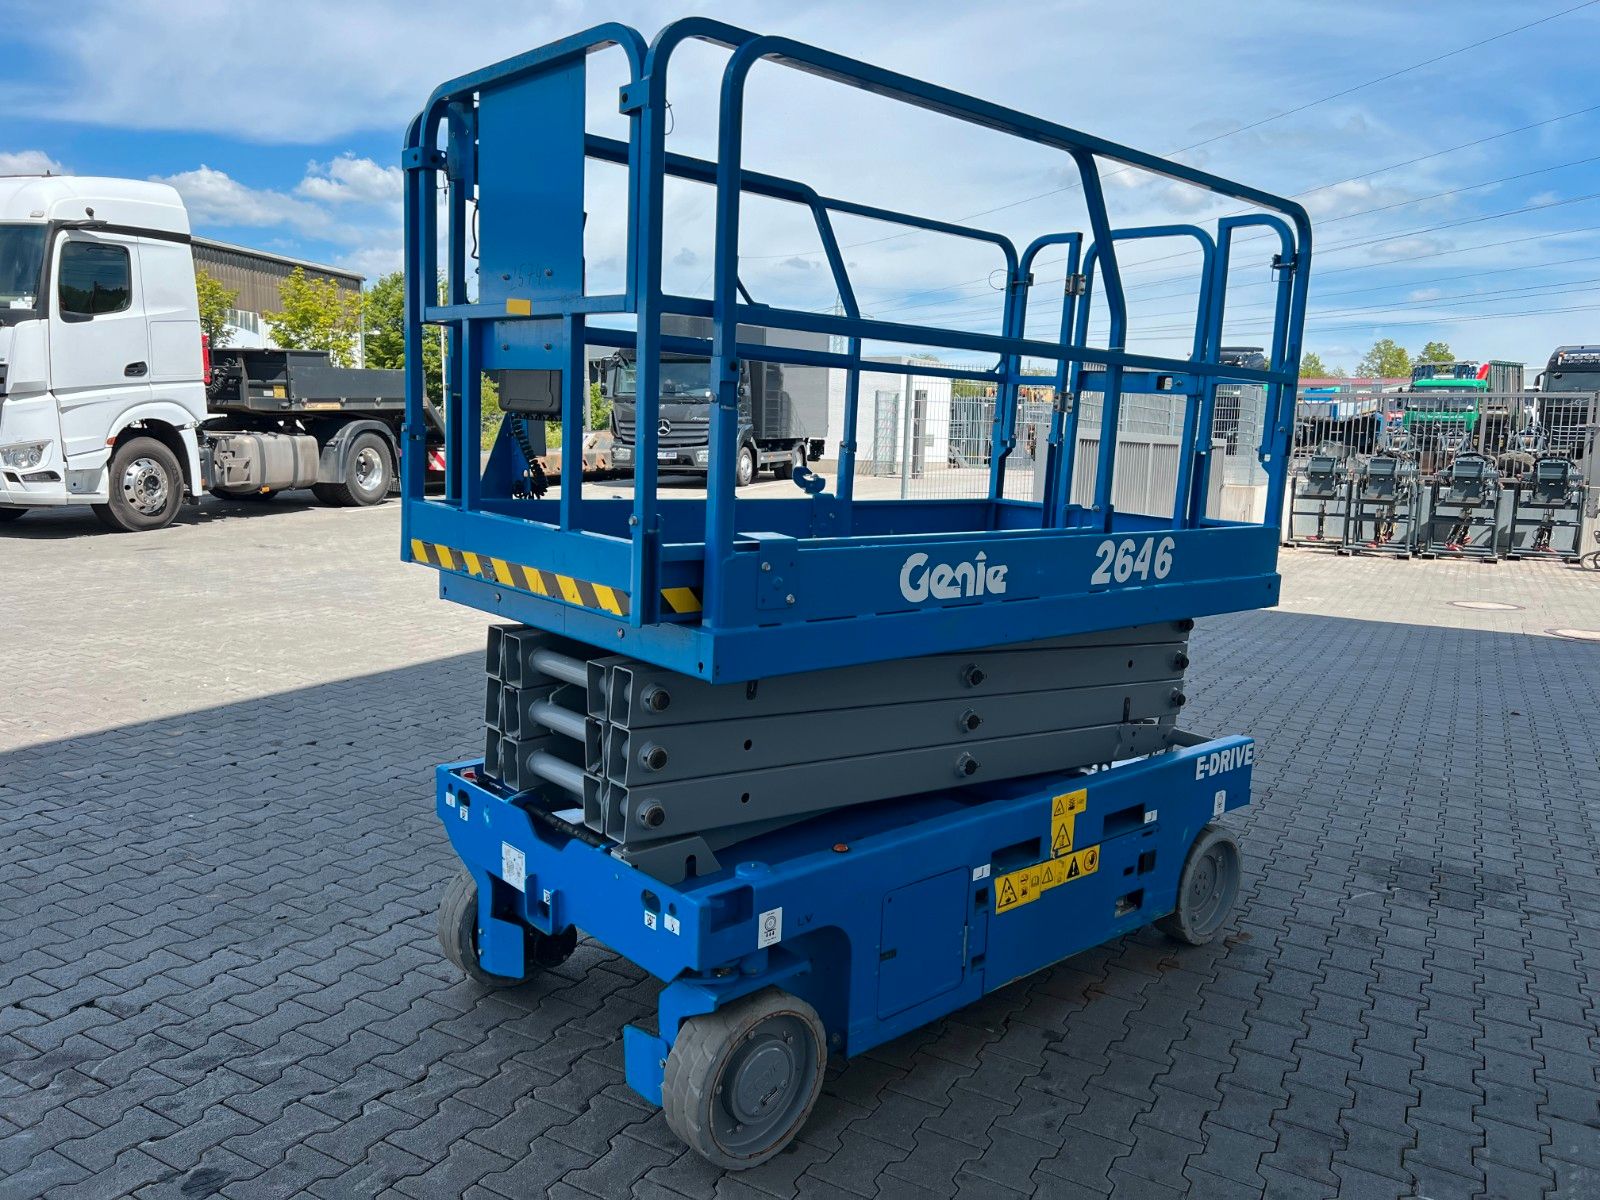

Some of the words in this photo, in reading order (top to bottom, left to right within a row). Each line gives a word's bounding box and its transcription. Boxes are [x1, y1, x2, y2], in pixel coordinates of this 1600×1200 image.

[900, 550, 1008, 603] Genie
[1091, 536, 1175, 585] 2646
[1195, 742, 1254, 780] E-DRIVE
